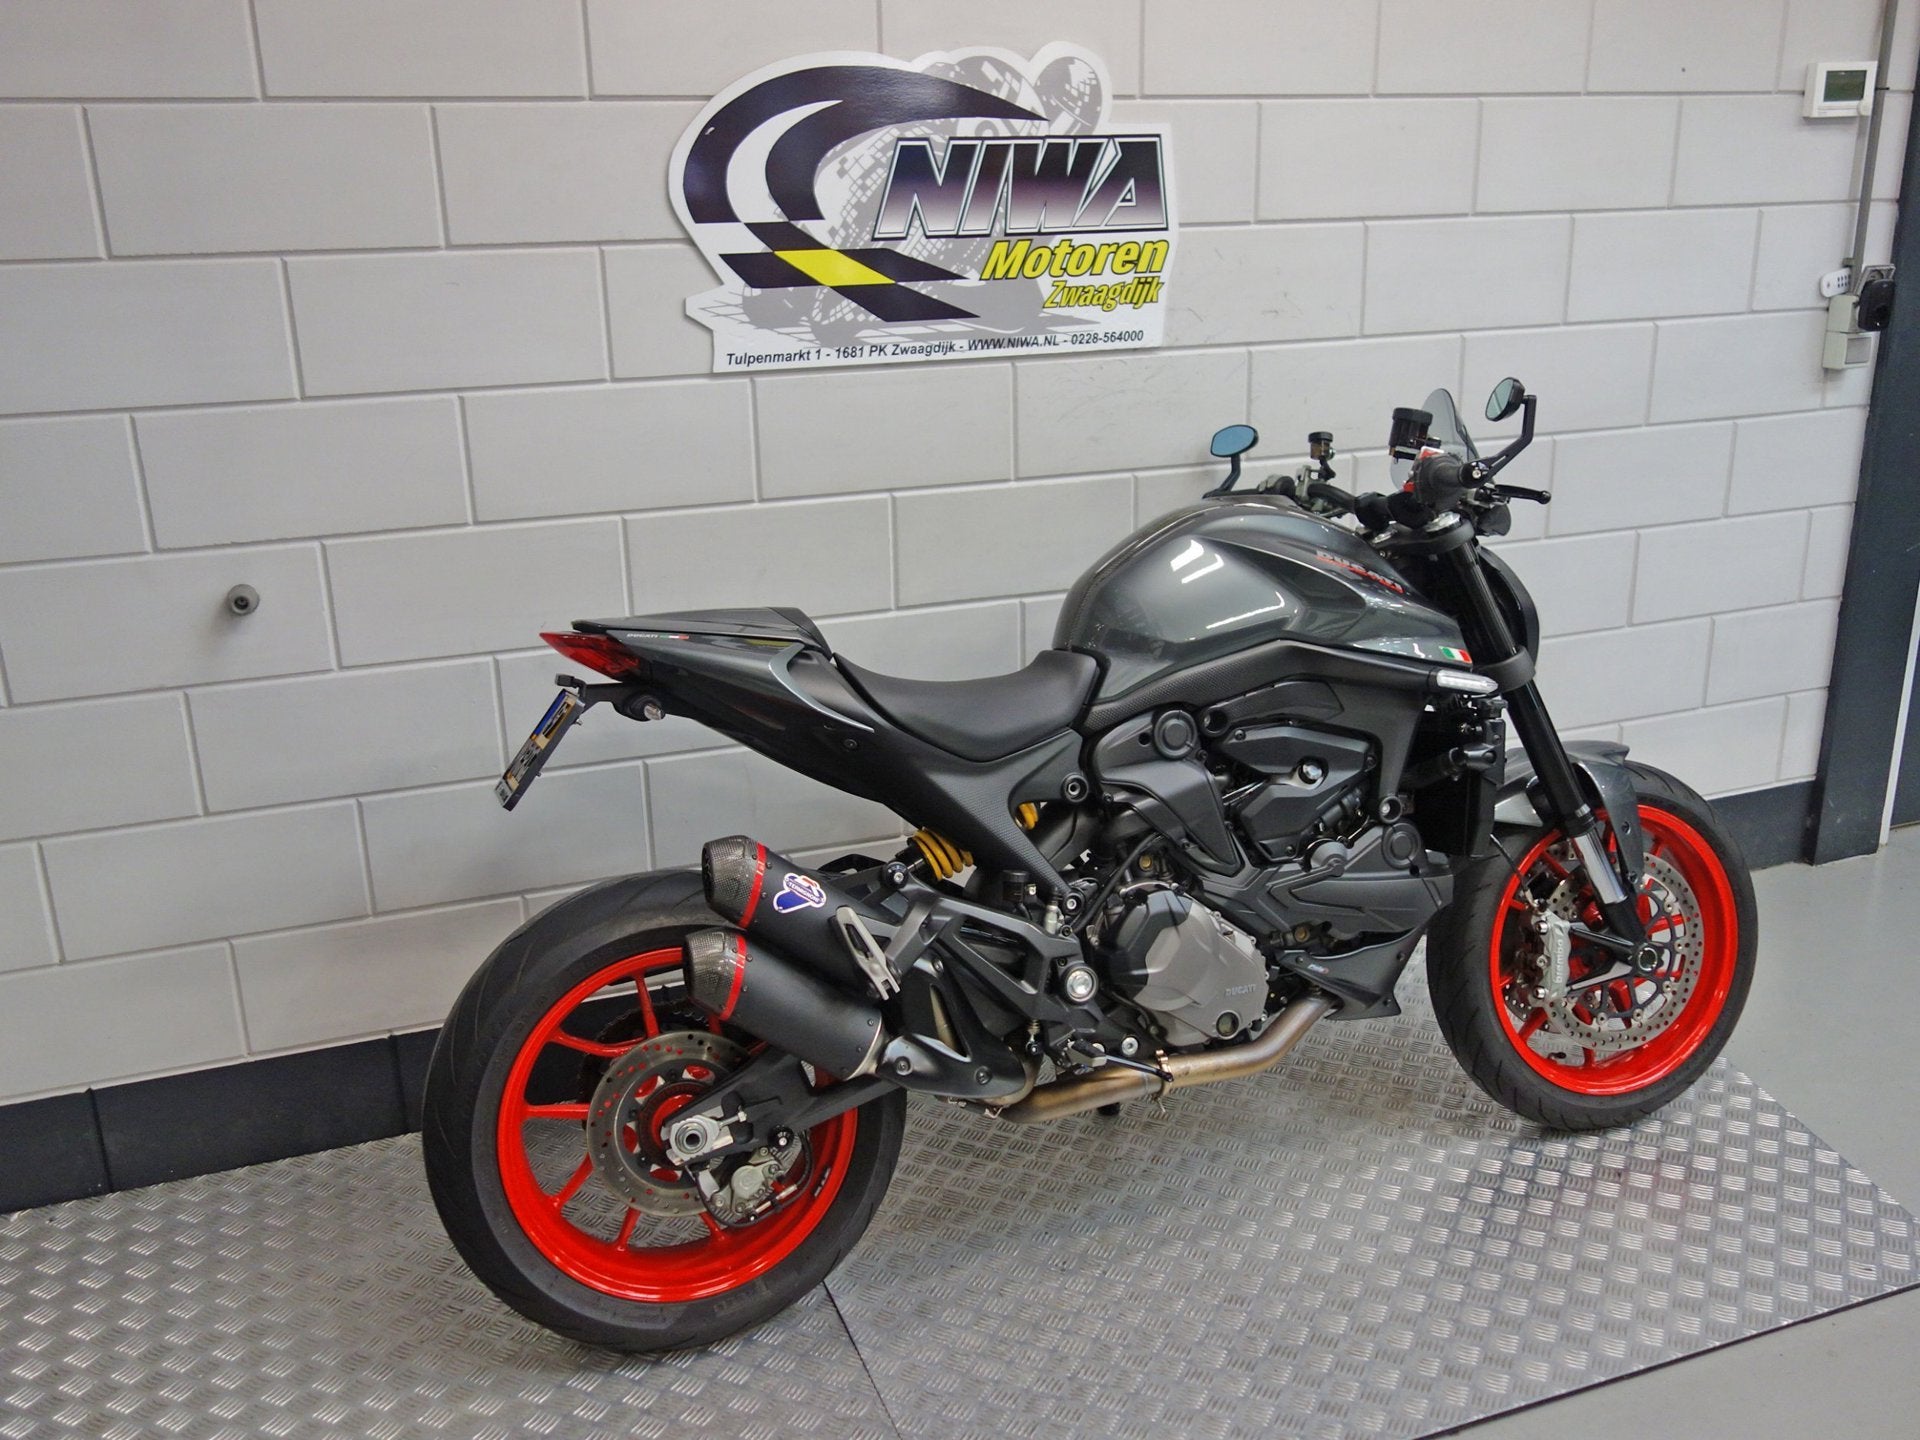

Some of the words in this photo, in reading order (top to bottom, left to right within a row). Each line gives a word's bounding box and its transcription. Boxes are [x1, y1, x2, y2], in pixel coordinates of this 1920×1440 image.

[872, 134, 1169, 241] NIWA
[979, 238, 1170, 281] Motoren
[1043, 276, 1165, 312] Zwaagdijk
[726, 348, 811, 367] Tulpenmarkt
[815, 348, 822, 360] 1
[835, 346, 864, 359] 1681
[868, 344, 888, 357] PK
[891, 341, 956, 356] Zwaagdijk
[967, 335, 1060, 351] WWW.NIWA.NL
[1070, 330, 1145, 345] 0228-564000
[1554, 938, 1564, 984] brembo
[1224, 983, 1257, 997] DUCATI
